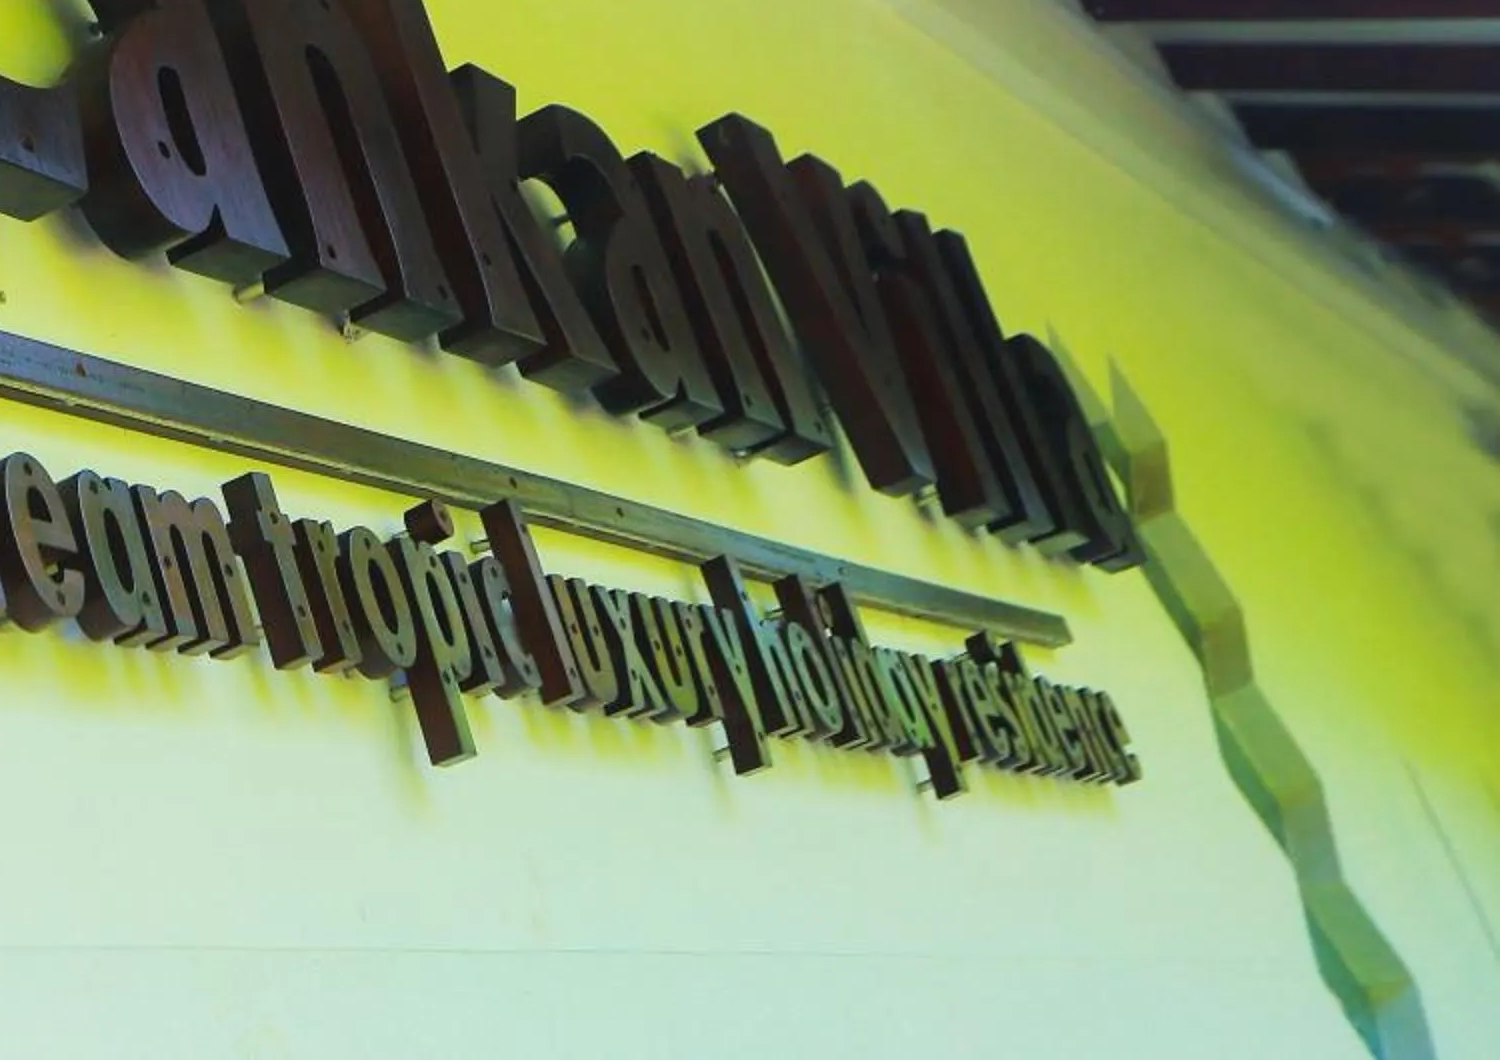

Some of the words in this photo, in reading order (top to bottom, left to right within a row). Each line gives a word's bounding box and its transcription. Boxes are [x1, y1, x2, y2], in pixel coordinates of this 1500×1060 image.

[694, 111, 1146, 574] Villa
[222, 471, 542, 768] tropic
[479, 498, 773, 777] luxury
[701, 554, 970, 801] holiday
[931, 628, 1143, 787] residence
